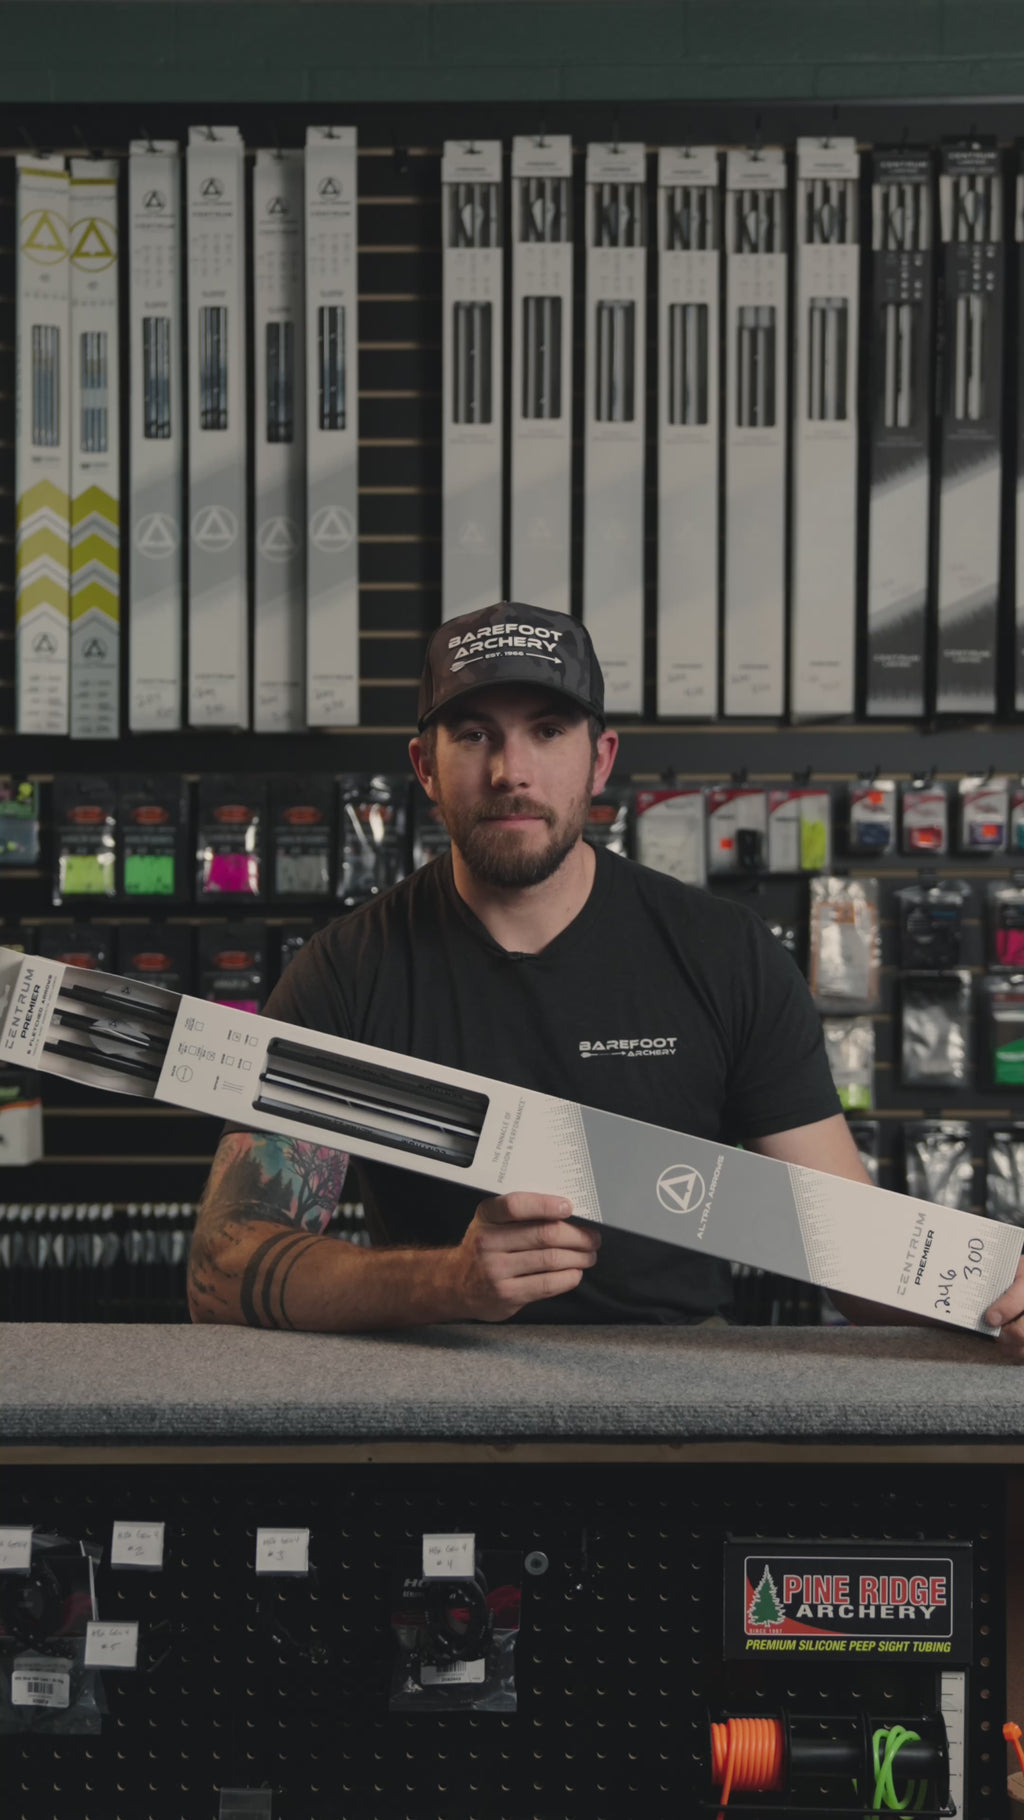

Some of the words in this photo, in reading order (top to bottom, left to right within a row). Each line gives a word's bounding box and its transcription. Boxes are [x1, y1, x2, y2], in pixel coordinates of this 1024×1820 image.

[448, 623, 563, 649] BAREFOOT
[454, 636, 558, 660] ARCHERY
[484, 651, 503, 659] EST.
[4, 968, 35, 1050] CENTRUM
[20, 984, 42, 1040] PREMIER
[29, 1008, 44, 1047] FLETCHED
[41, 974, 53, 1004] ARROWS
[579, 1037, 678, 1051] BAREFOOT
[626, 1048, 677, 1057] ARCHERY
[697, 1201, 713, 1240] ALTRA
[708, 1154, 725, 1199] ARROWS
[896, 1212, 928, 1296] CENTRUM
[914, 1229, 936, 1285] PREMIER
[963, 1238, 985, 1280] 300
[783, 1574, 850, 1605] PINE
[859, 1575, 947, 1606] RIDGE
[795, 1605, 936, 1620] ARCHERY
[745, 1639, 797, 1651] PREMIUM
[798, 1640, 847, 1651] SILICONE
[848, 1640, 876, 1652] PEEP
[877, 1641, 910, 1652] SIGHT
[912, 1641, 952, 1653] TUBING
